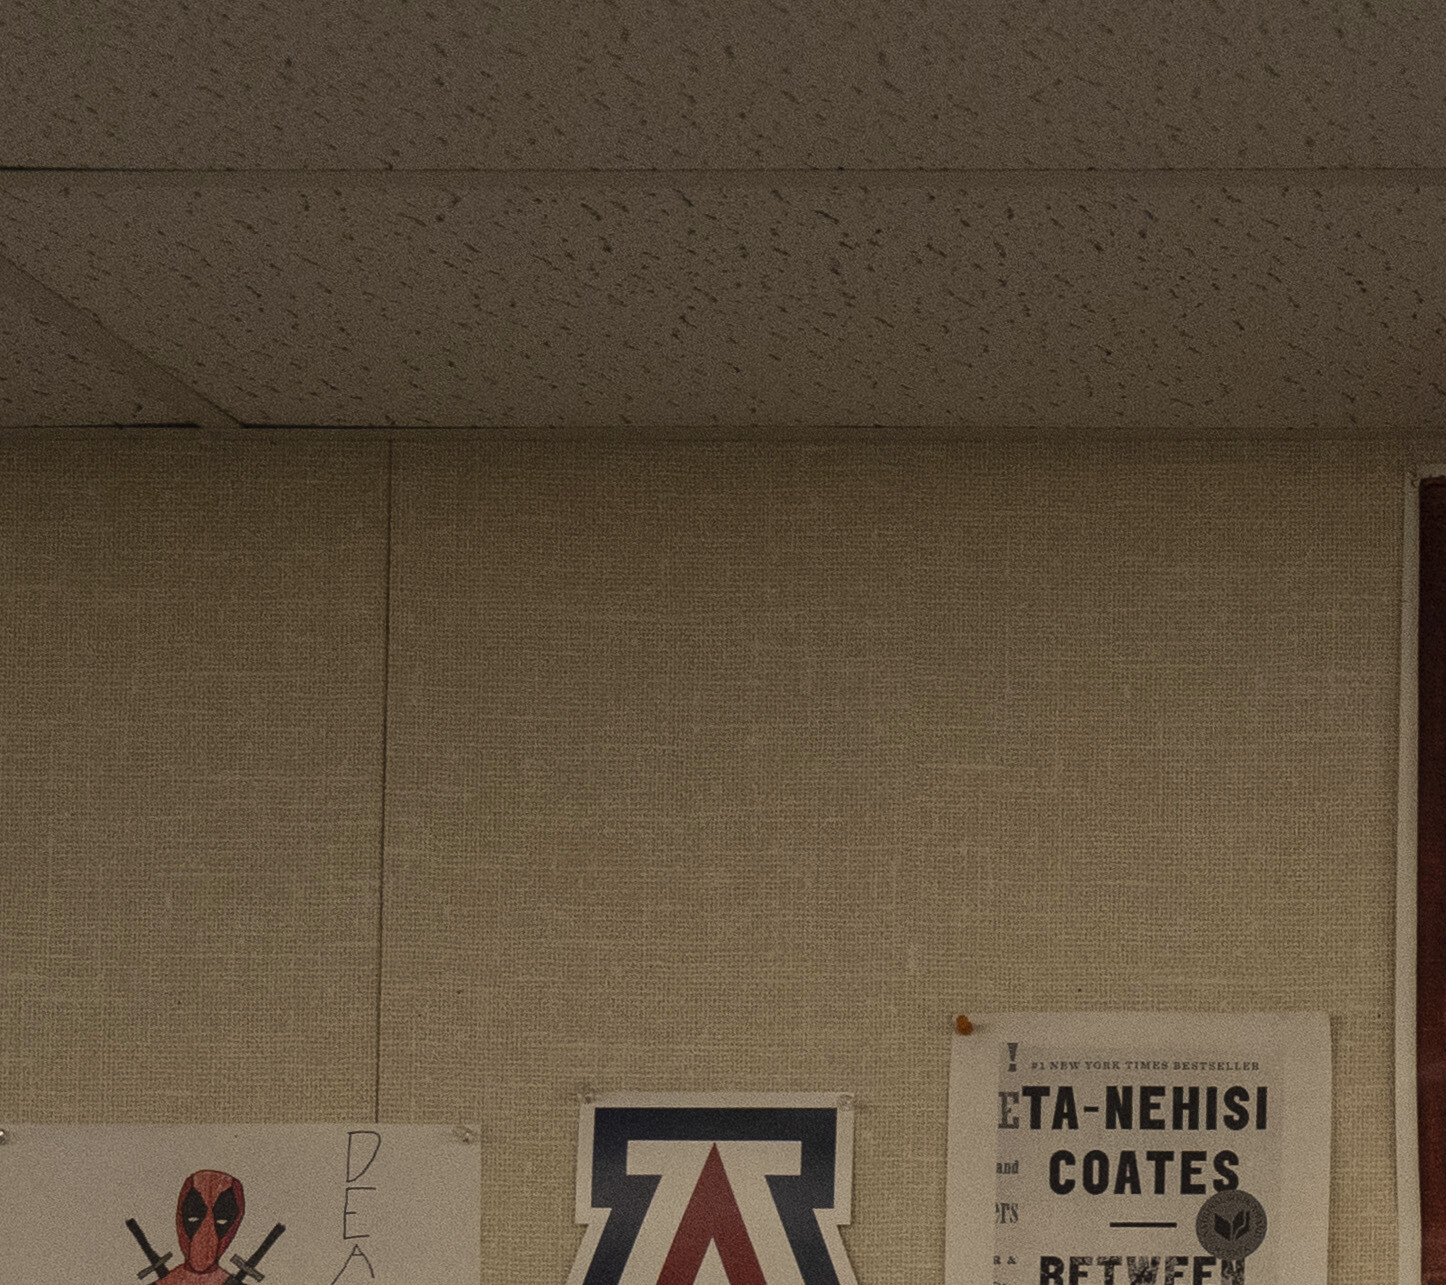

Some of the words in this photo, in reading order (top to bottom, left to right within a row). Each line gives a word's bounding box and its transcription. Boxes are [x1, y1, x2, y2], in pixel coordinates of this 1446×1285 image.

[1050, 1061, 1080, 1070] NEW
[1084, 1061, 1121, 1070] YORK
[1125, 1061, 1169, 1070] TIMES
[1173, 1061, 1260, 1072] BESTSELLER
[1022, 1085, 1268, 1131] TA-NEHISI
[1049, 1149, 1239, 1195] COATES
